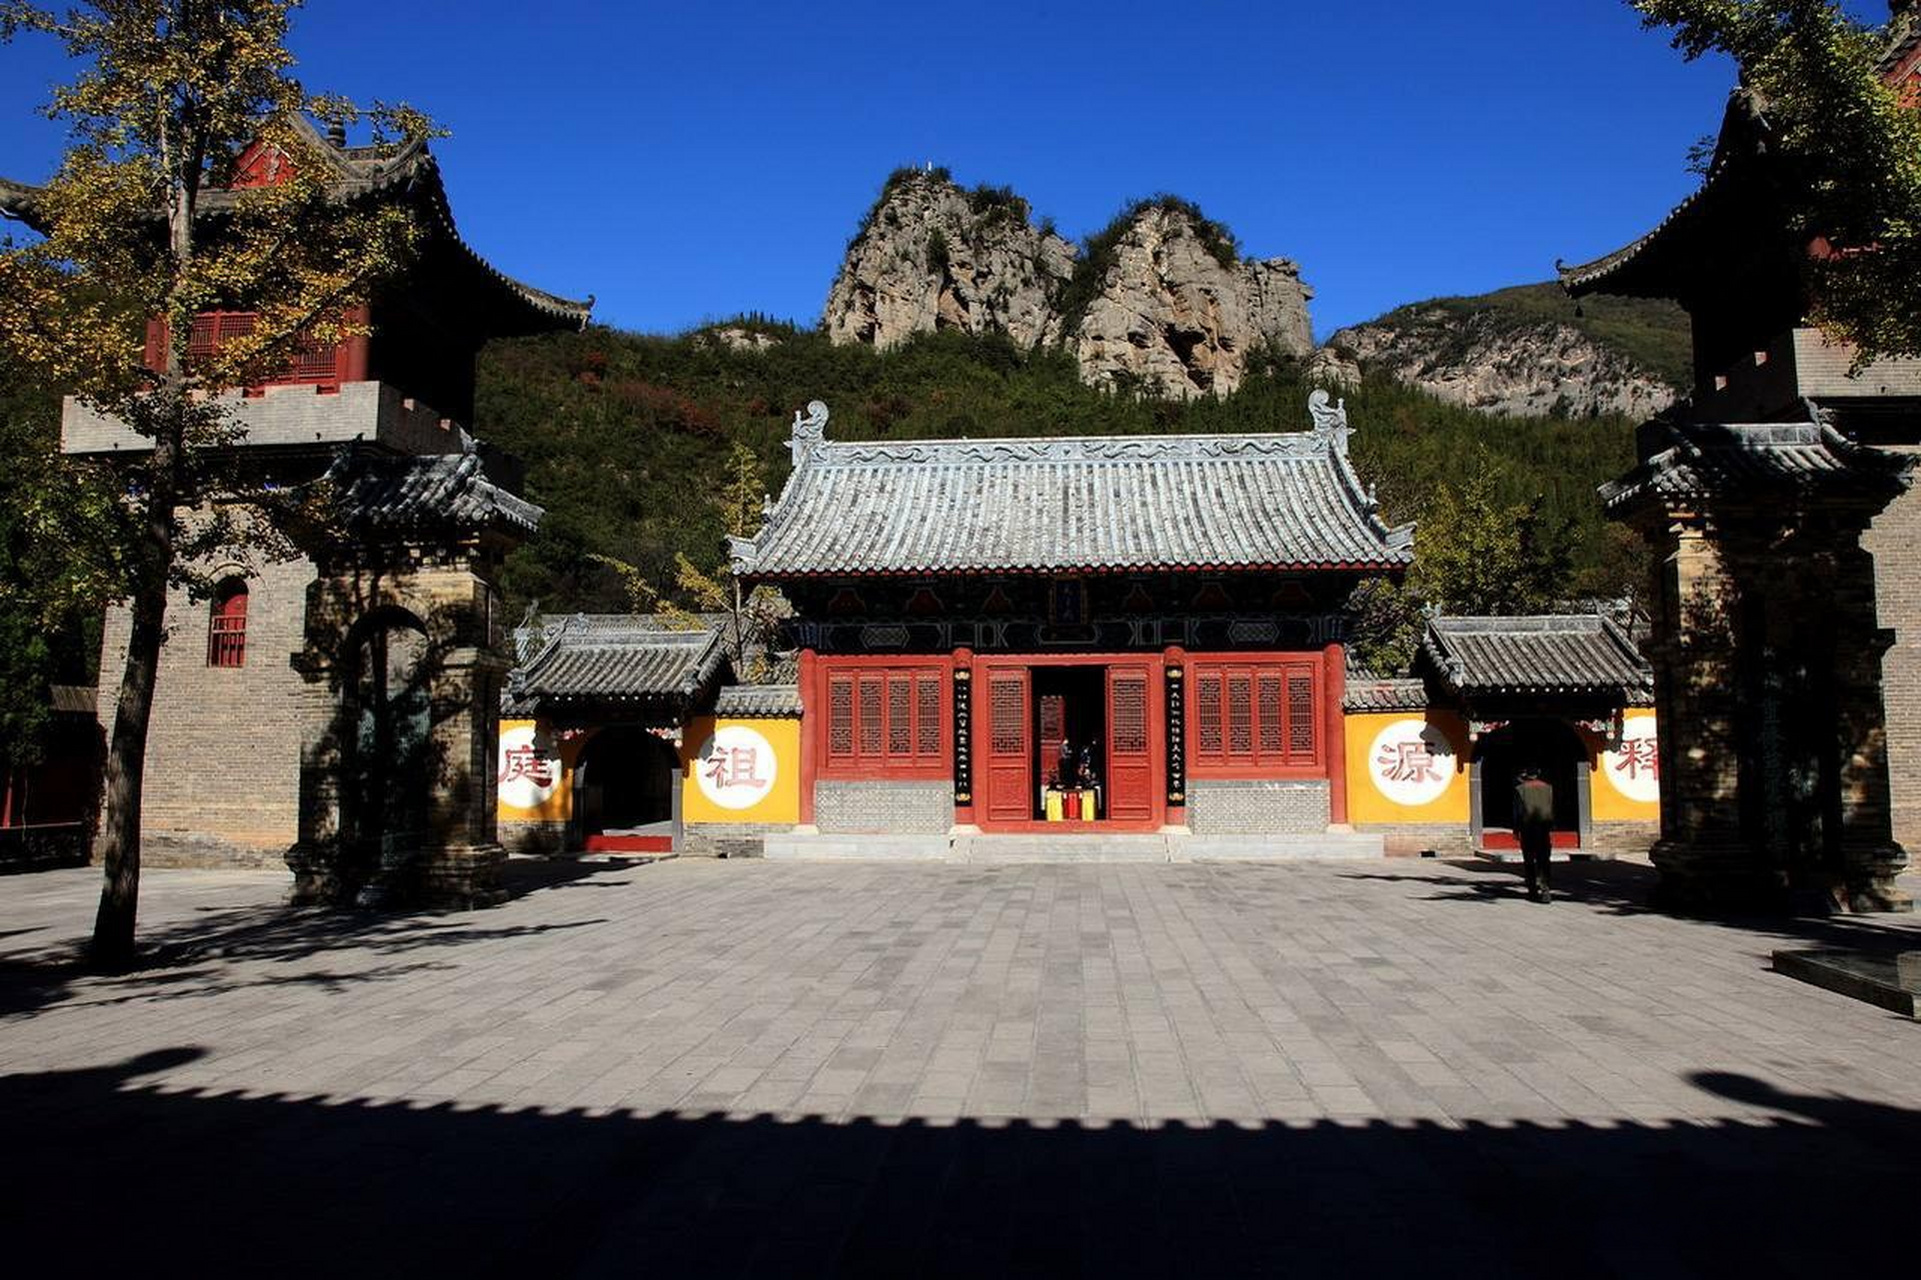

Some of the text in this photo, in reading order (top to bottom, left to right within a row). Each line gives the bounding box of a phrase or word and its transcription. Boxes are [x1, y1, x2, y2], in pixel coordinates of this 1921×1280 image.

[499, 744, 553, 788] 庭
[706, 746, 767, 789] 祖
[1377, 741, 1442, 783] 源
